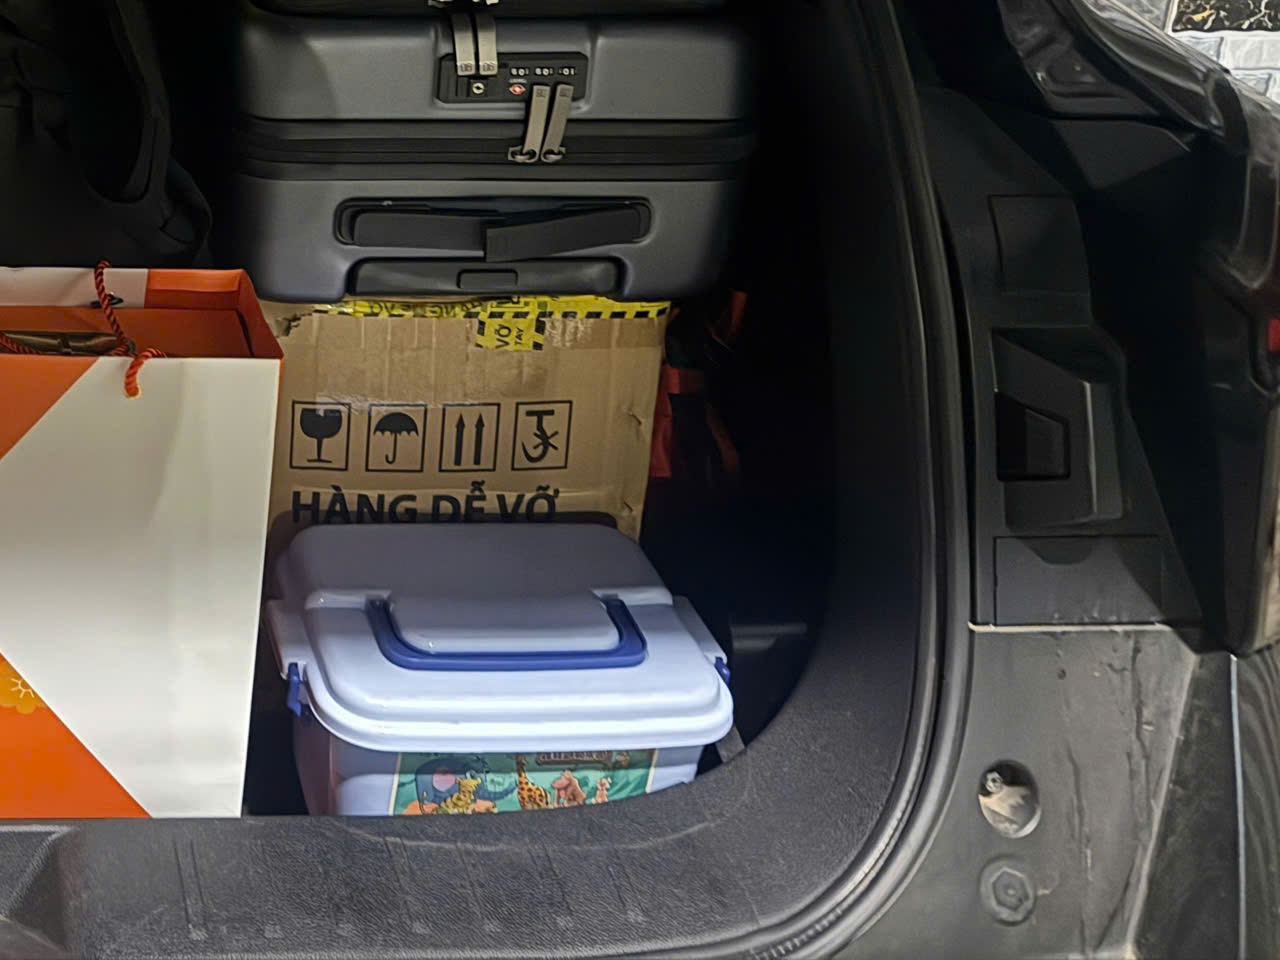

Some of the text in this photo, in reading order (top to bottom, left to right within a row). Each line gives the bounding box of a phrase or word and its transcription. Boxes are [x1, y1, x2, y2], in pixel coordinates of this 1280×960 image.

[515, 327, 523, 345] TAY
[291, 480, 561, 524] HÀNG DỄ VỠ
